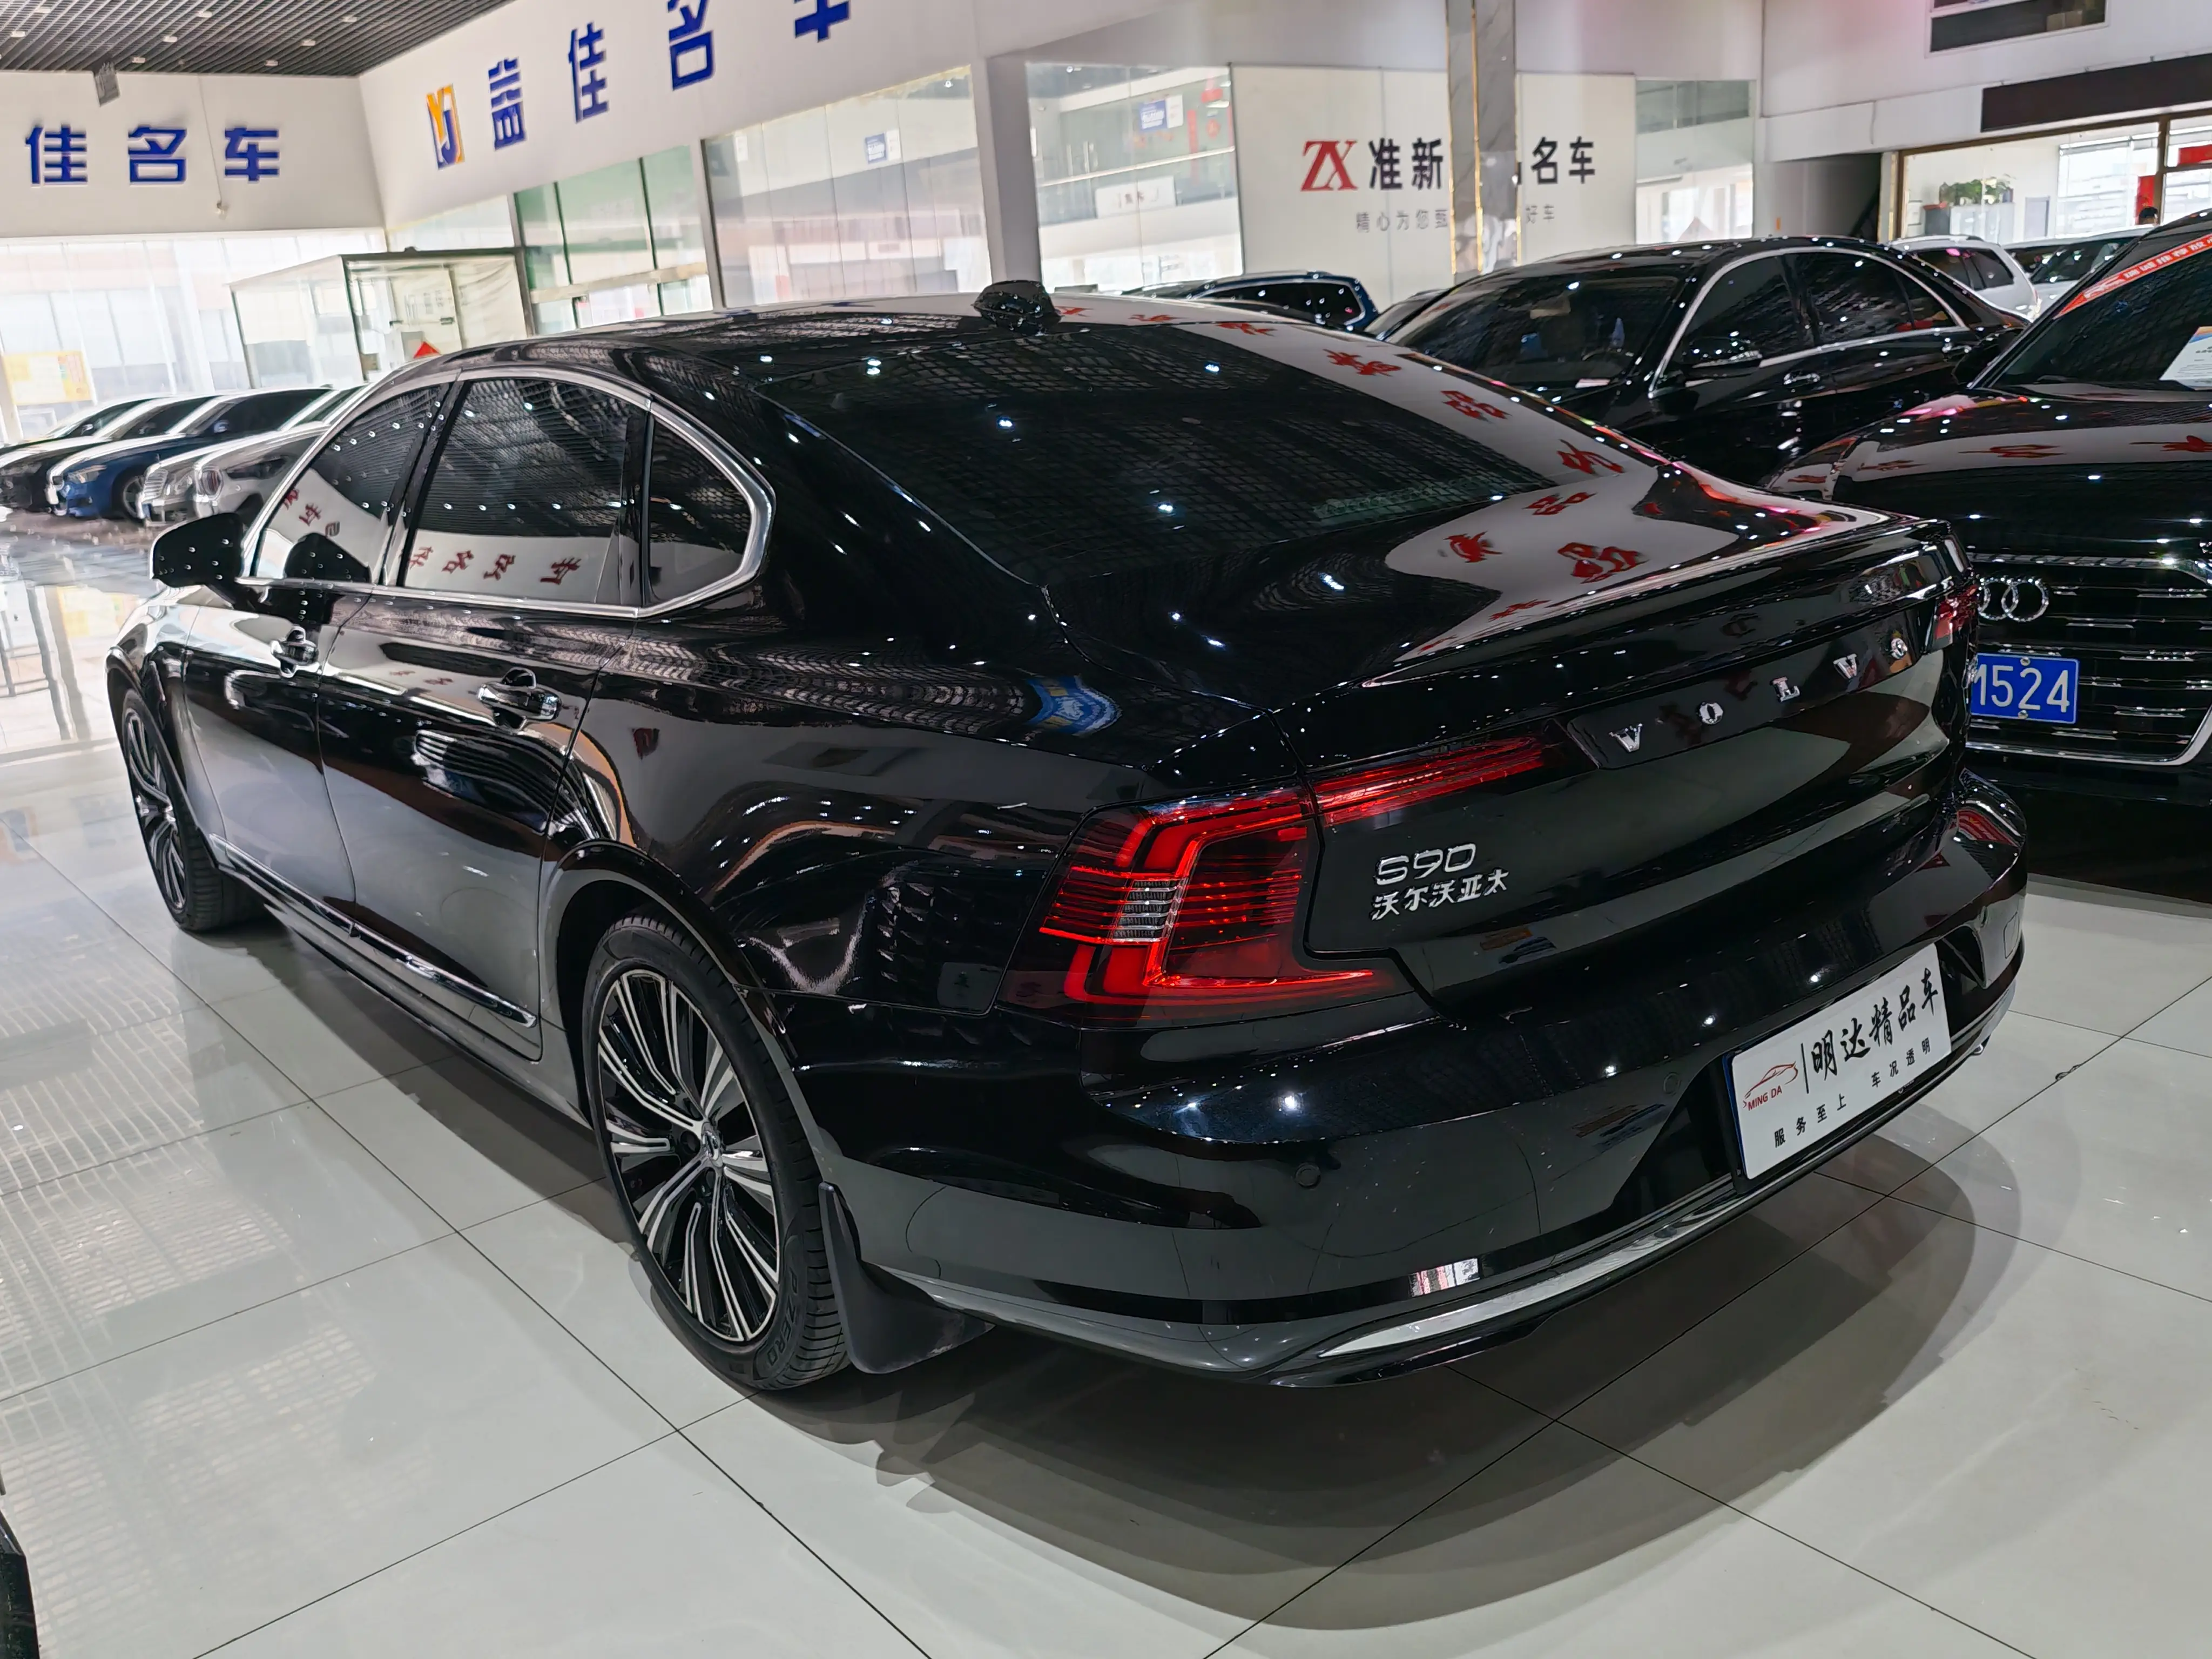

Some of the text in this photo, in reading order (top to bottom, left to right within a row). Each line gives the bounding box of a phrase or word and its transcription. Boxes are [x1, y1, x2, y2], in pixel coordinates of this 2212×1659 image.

[1609, 637, 1908, 752] VOLVO
[1371, 868, 1509, 921] 沃尔沃亚太
[1373, 843, 1476, 886] S90
[1811, 967, 1939, 1081] 明达精品车
[1748, 1084, 1783, 1111] MING DA
[1774, 1036, 1931, 1148] 服务至上 车况透明
